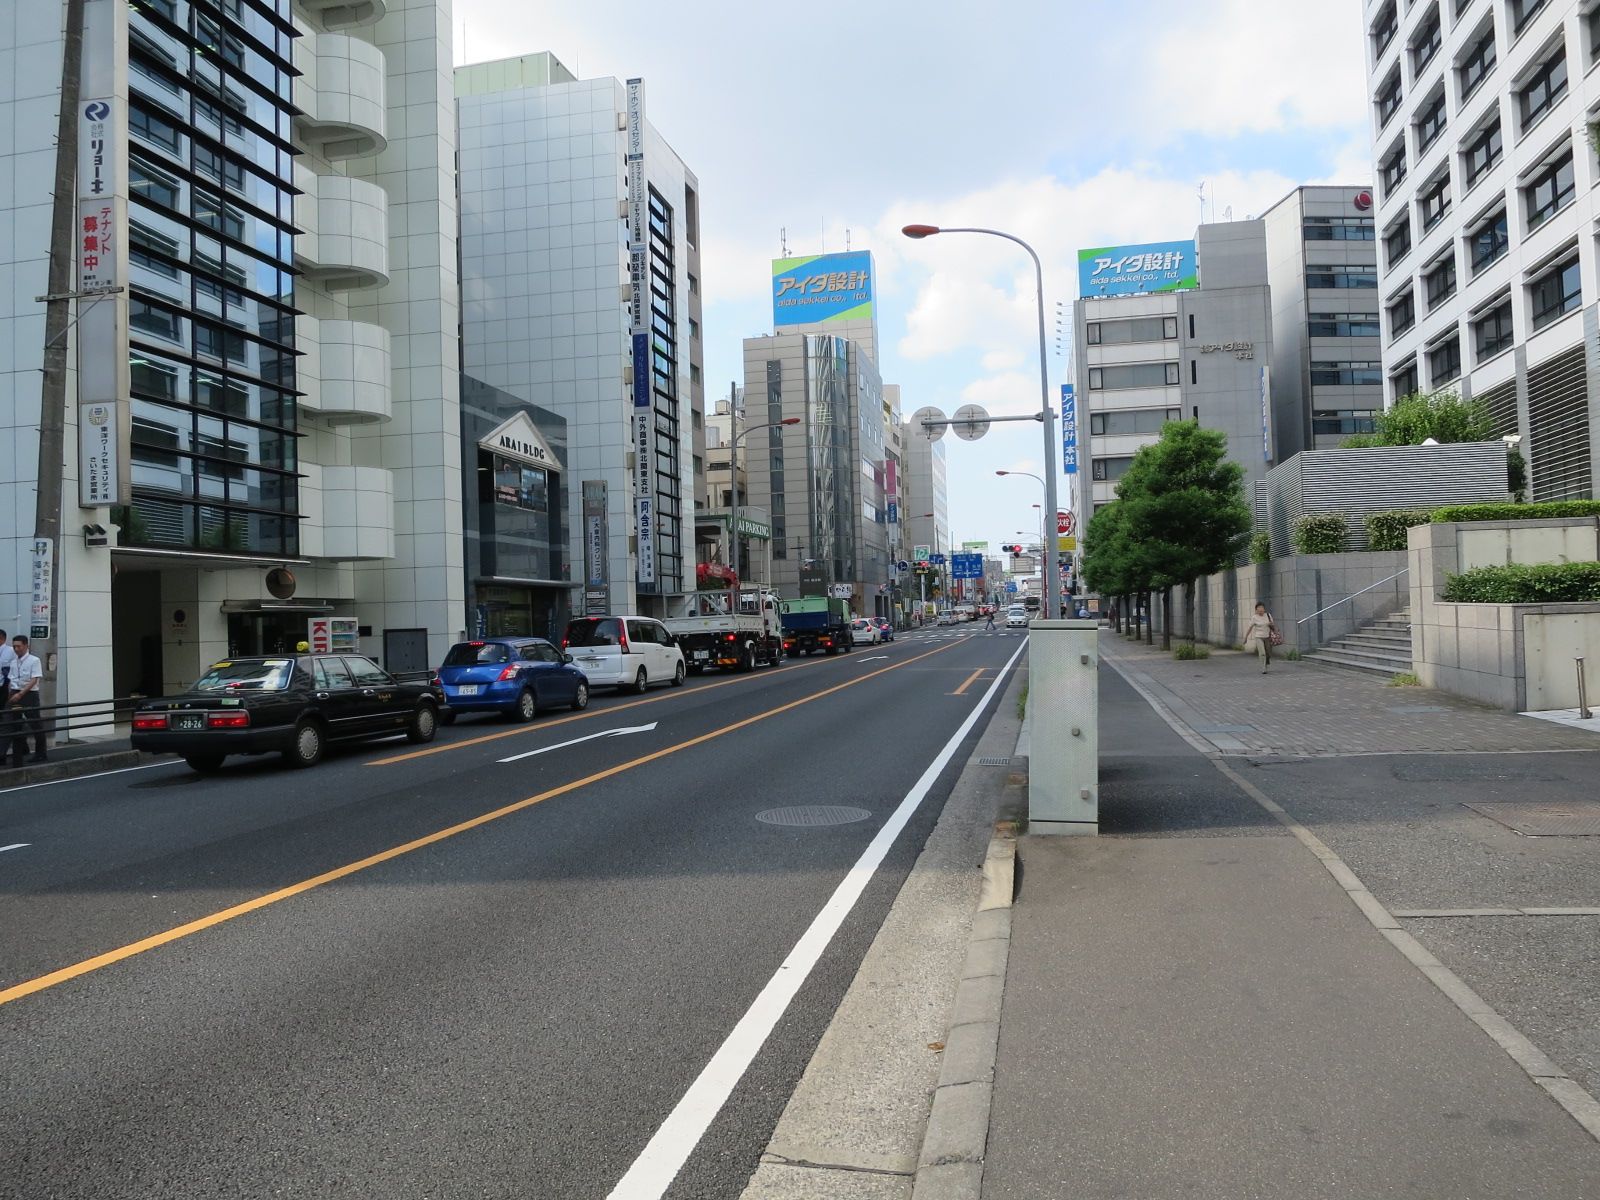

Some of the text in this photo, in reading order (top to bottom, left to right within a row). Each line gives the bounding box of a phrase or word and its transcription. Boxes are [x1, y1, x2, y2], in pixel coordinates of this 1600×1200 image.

[91, 139, 104, 194] リョーキ
[83, 216, 98, 271] 募集中
[101, 207, 112, 255] テナント
[1091, 251, 1184, 276] アイダ設計
[776, 269, 869, 297] アイダ設計
[1090, 276, 1109, 285] aida
[1110, 274, 1141, 283] sekkei
[777, 298, 797, 307] aida
[798, 296, 830, 305] sekkei
[1062, 392, 1075, 465] アイダ設計 本社
[499, 435, 545, 460] ARAI BLDG
[640, 501, 650, 540] 阿含宗
[745, 521, 770, 537] PARKING
